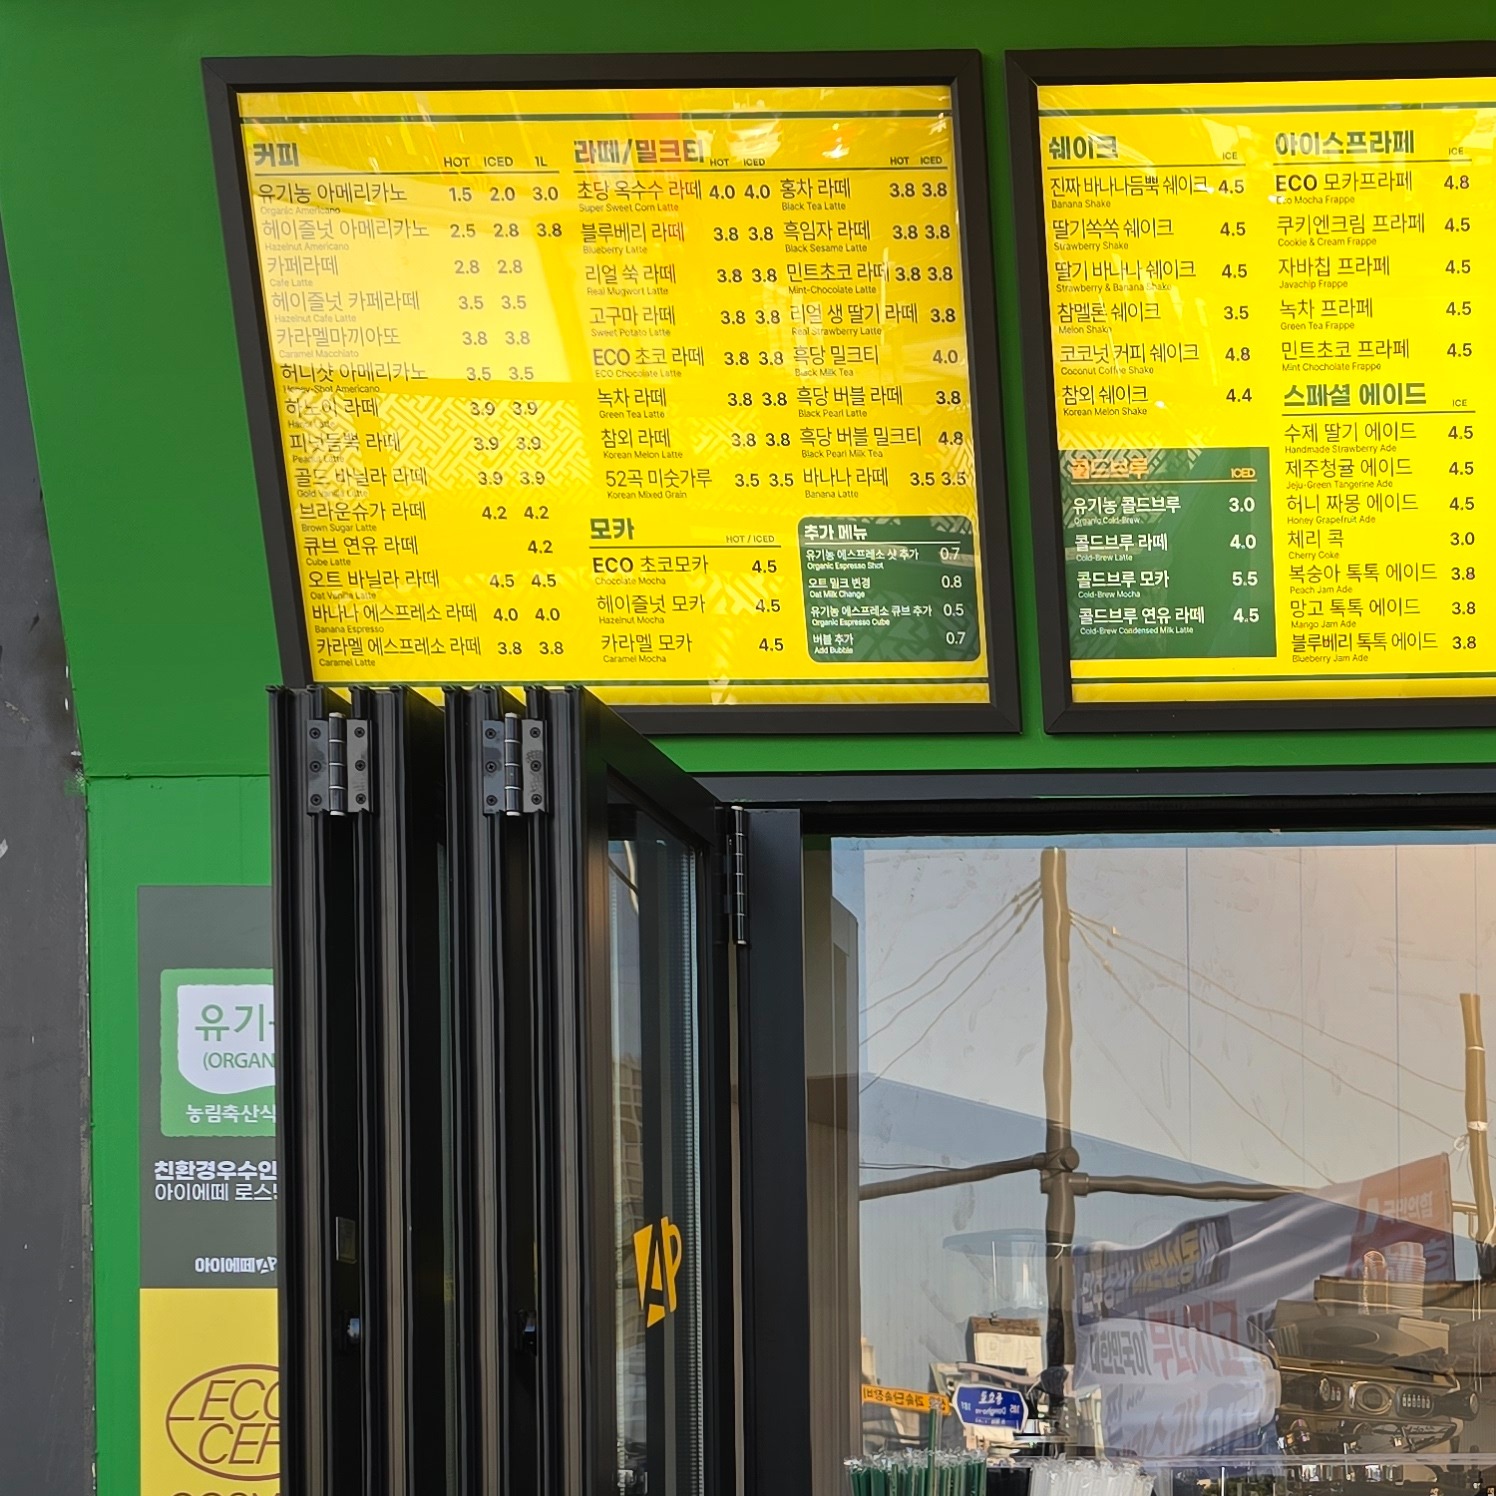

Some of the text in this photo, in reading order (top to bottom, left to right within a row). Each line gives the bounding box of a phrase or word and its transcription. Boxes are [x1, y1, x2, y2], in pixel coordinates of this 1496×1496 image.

[1049, 136, 1237, 160] 쉐이크 ICE
[1275, 130, 1414, 156] 아이스프라페
[252, 142, 548, 168] 커피 HOT ICED 1L
[258, 182, 558, 204] 유기농 아메리카노 1.5 2.0 3.0
[577, 179, 770, 201] 초당 옥수수 라떼 4.0 4.0
[260, 206, 340, 215] Organic Americano
[782, 202, 845, 210] Black Tea Latte
[1053, 218, 1246, 239] 딸기쏙쏙 쉐이크 4.5
[1277, 213, 1470, 235] 쿠키엔크림 프라페 4.5
[1284, 383, 1426, 407] 스페셜 에이드
[300, 501, 549, 521] 브라운슈가 라떼 4.2 4.2
[1073, 497, 1255, 514] 유기농 콜드브루 3.0
[591, 518, 634, 540] 모카
[804, 525, 868, 540] 추가 메뉴
[1288, 530, 1475, 548] 체리 콕 3.0
[593, 555, 777, 575] ECO 초코모카 4.5
[1289, 551, 1339, 560] Cherry Coke
[195, 1004, 274, 1041] 유기
[154, 1160, 277, 1180] 친환경우수인
[155, 1183, 277, 1201] 아이에떼 로스
[195, 1258, 255, 1272] 아이에떼
